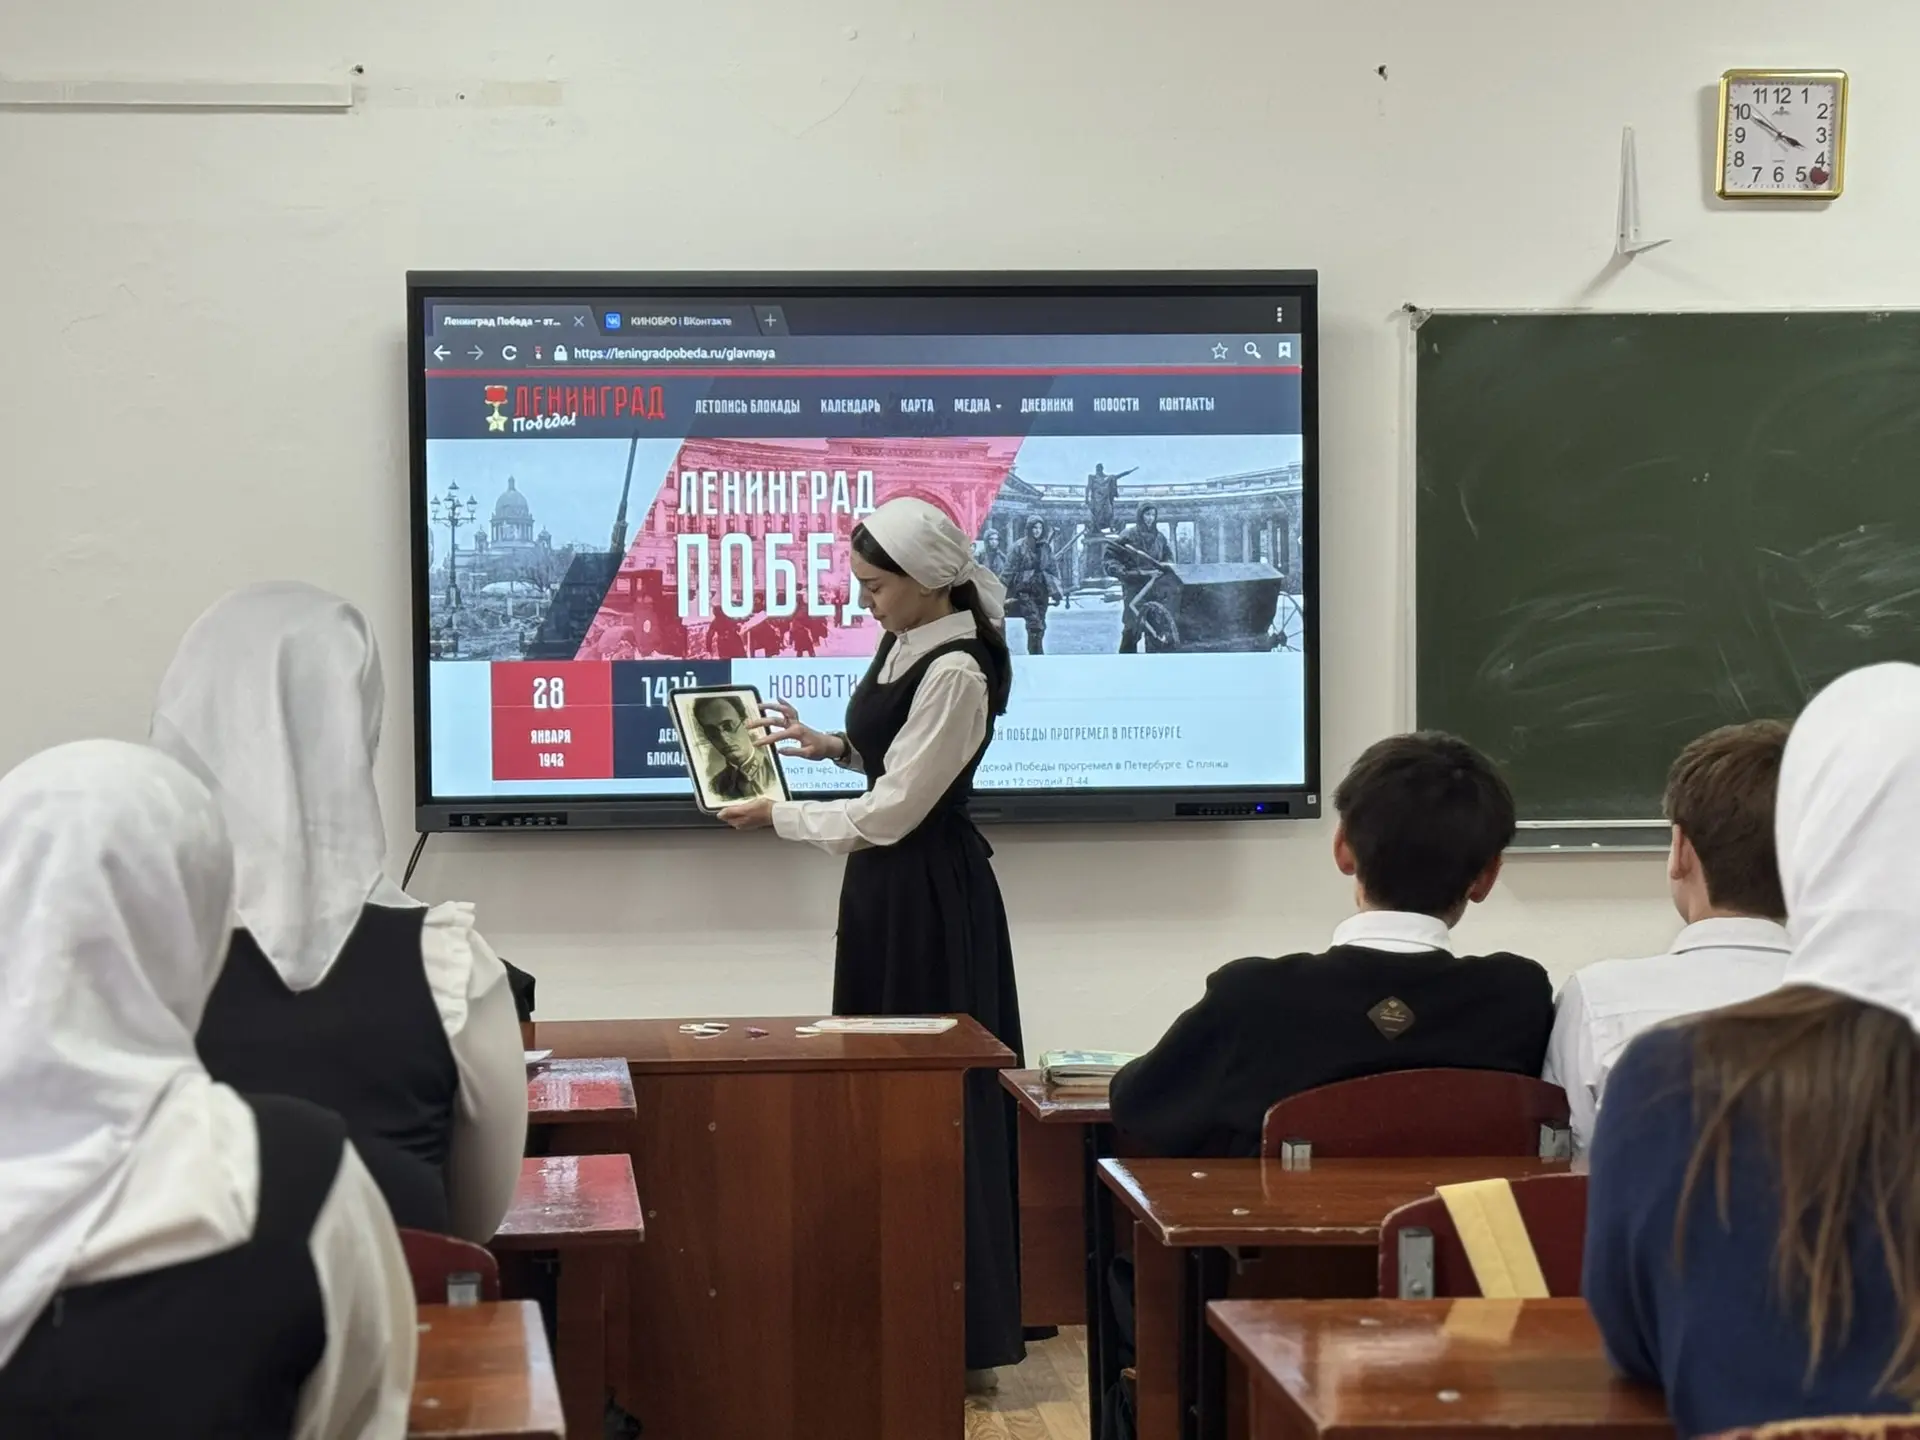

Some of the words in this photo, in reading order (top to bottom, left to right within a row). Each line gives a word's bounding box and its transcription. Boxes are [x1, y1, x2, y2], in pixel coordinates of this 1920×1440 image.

[1753, 88, 1767, 104] 11
[1773, 87, 1791, 104] 12
[1801, 87, 1808, 104] 1
[1734, 103, 1751, 120] 10
[1817, 103, 1828, 119] 2
[1735, 127, 1745, 143] 9
[1816, 127, 1827, 143] 3
[1734, 151, 1744, 167] 8
[1815, 152, 1825, 167] 4
[1752, 167, 1762, 183] 7
[1773, 167, 1784, 183] 6
[1796, 166, 1806, 182] 5
[444, 316, 495, 328] Ленинград
[497, 316, 533, 327] Победа
[631, 316, 677, 326] КИНОБРО
[684, 316, 732, 326] ВКонтакте
[574, 347, 776, 361] https://leningradpobeda.ru/glavnaya
[514, 384, 666, 420] ЛЕНИНГРАД
[694, 399, 748, 414] ЛЕТОПИСЬ
[750, 399, 800, 414] БЛОКАДЫ
[820, 399, 881, 414] КАЛЕНДАРЬ
[900, 398, 934, 413] КАРТА
[953, 398, 991, 413] МЕДИА
[1020, 397, 1074, 413] ДНЕВНИКИ
[1093, 397, 1140, 412] НОВОСТИ
[1159, 397, 1215, 412] КОНТАКТЫ
[512, 411, 577, 433] Победа!
[677, 470, 876, 520] ЛЕНИНГРАД
[677, 533, 872, 626] ПОБЕ
[533, 677, 565, 709] 28
[769, 674, 858, 698] НОВОСТИ
[530, 729, 571, 744] ЯНВАРЯ
[658, 728, 679, 744] ДЕН
[1006, 727, 1047, 741] ПОБЕДЫ
[1050, 726, 1109, 741] ПРОГРЕМЕЛ
[1112, 726, 1118, 739] В
[1121, 725, 1183, 739] ПЕТЕРБУРГЕ
[538, 752, 564, 767] 1942
[646, 751, 687, 766] БЛОКАД
[1015, 762, 1055, 772] Победы
[1059, 762, 1112, 773] прогремел
